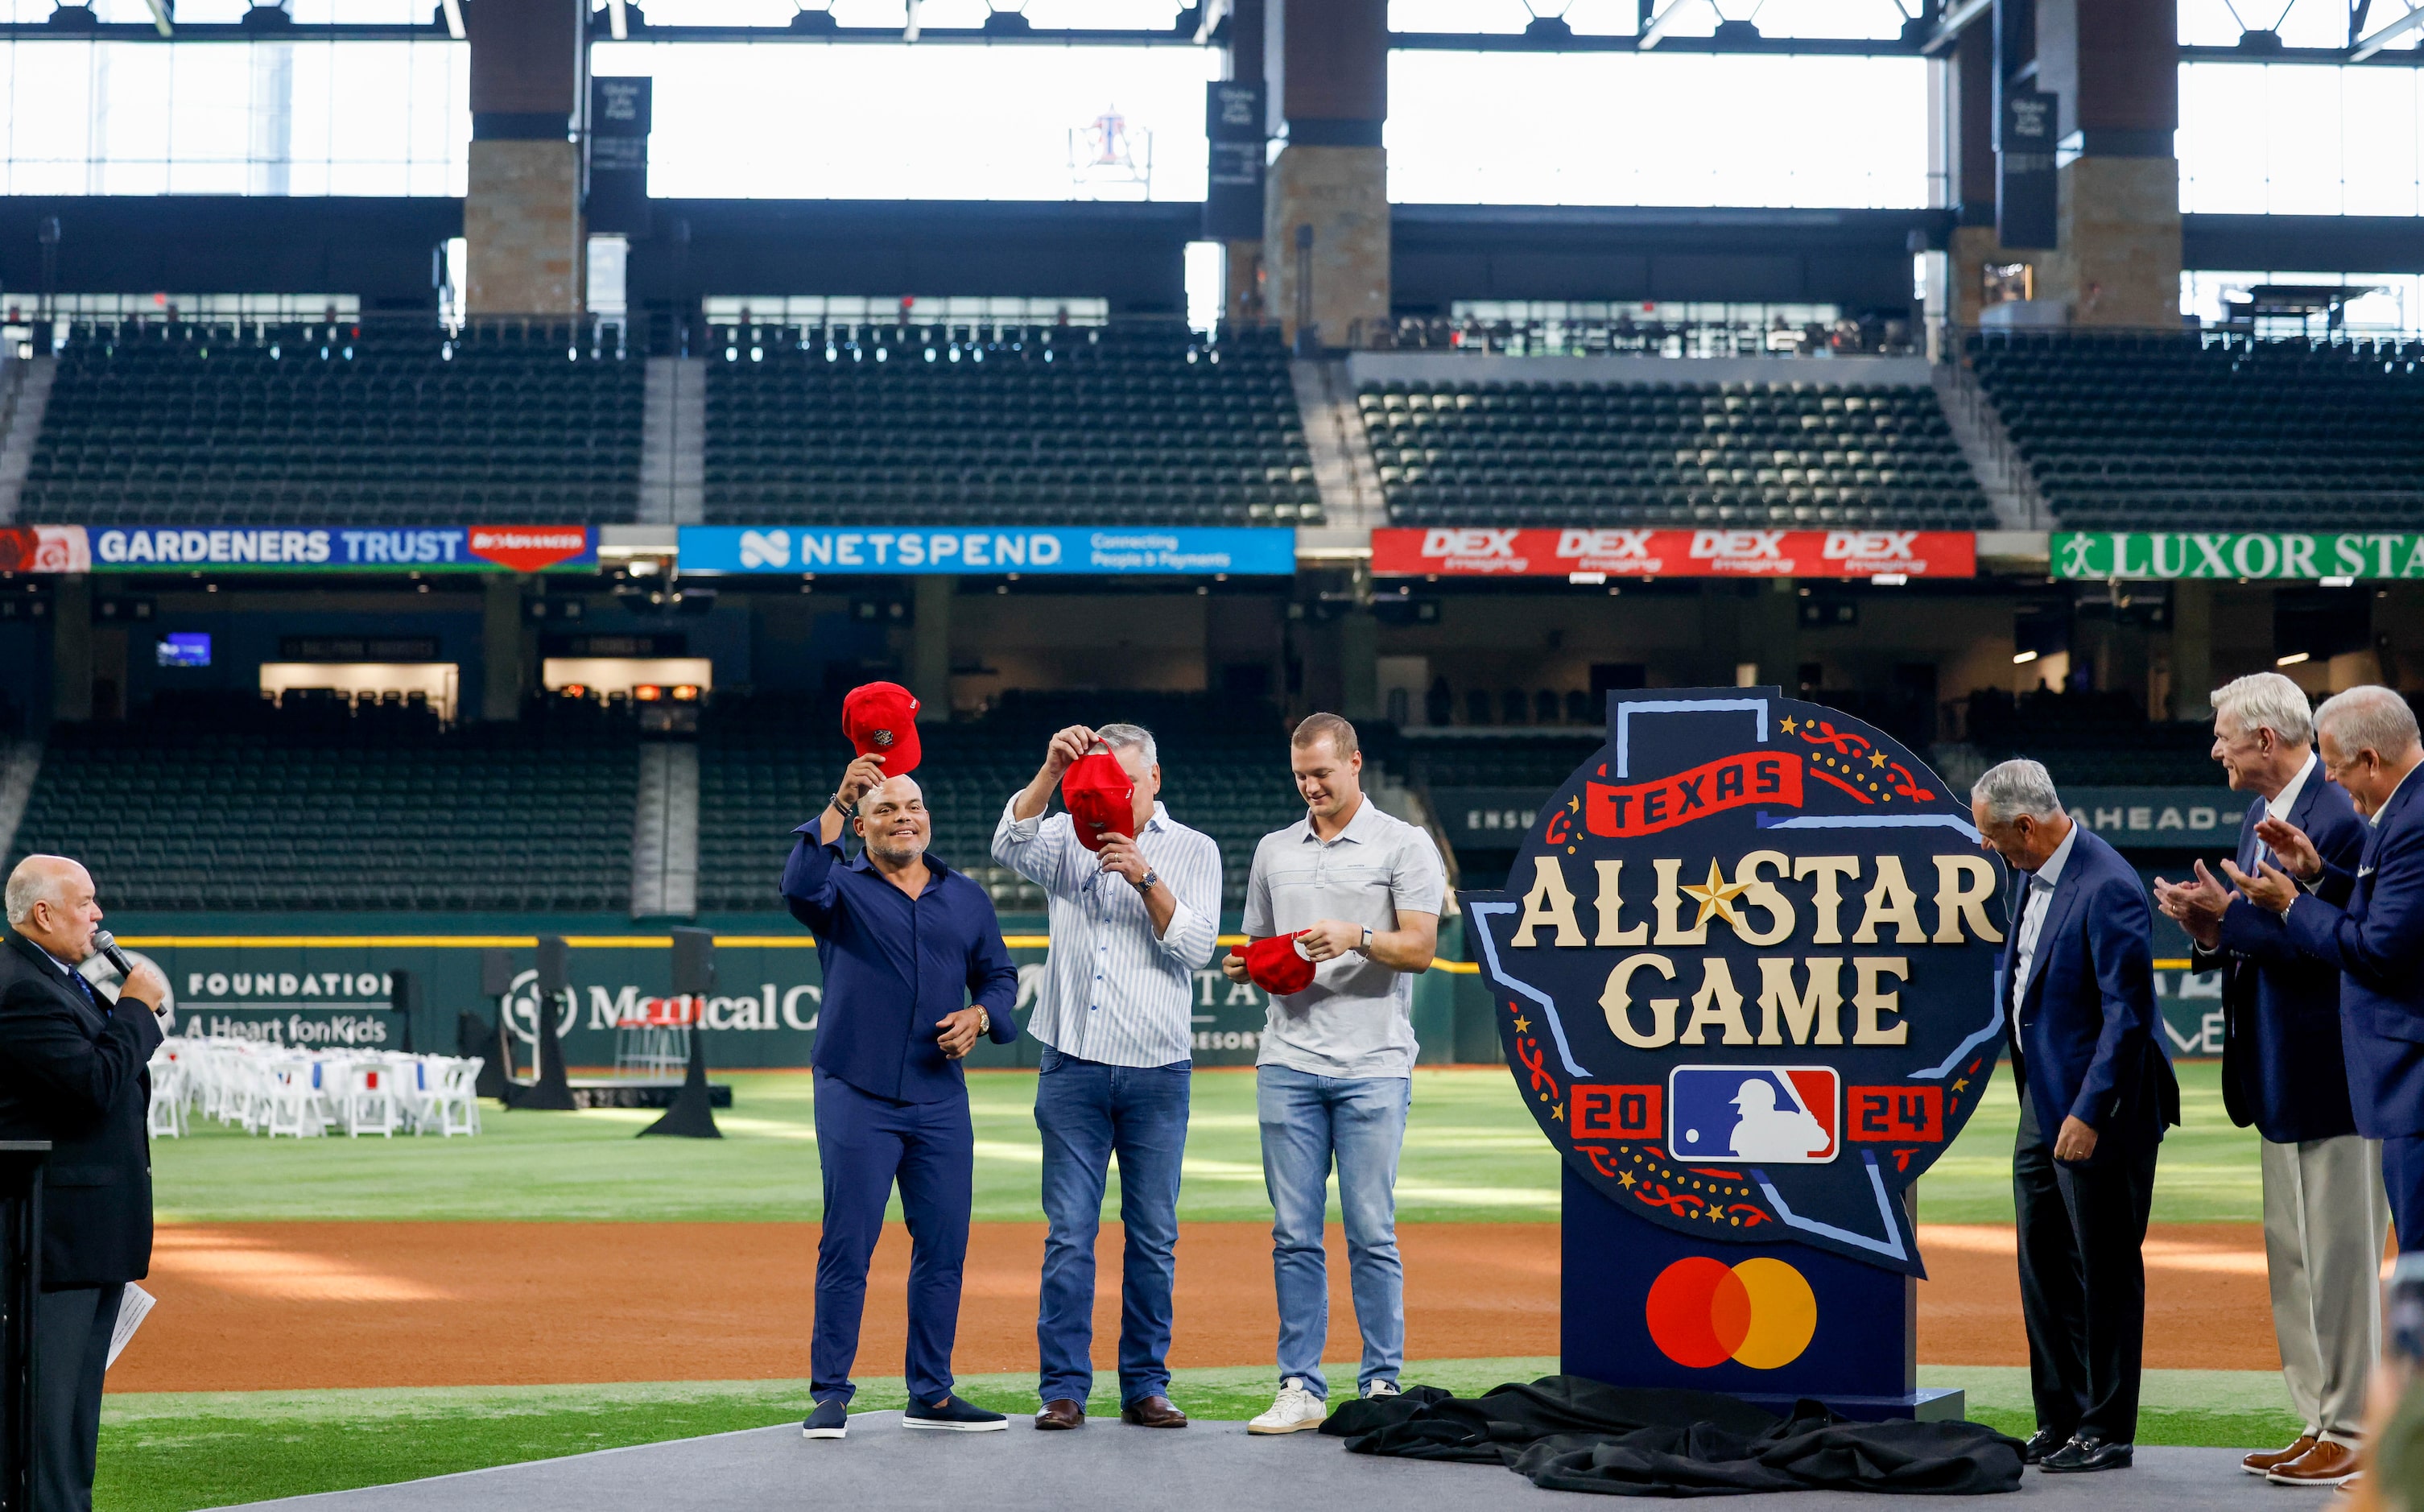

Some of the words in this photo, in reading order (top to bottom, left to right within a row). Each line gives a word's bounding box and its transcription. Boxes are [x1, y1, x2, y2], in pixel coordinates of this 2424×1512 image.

[98, 530, 331, 563] GARDENERS
[341, 531, 463, 562] TRUST
[801, 533, 1061, 566] NETSPEND
[1090, 532, 1179, 552] Connecting
[1421, 528, 1520, 558] DEX
[1555, 528, 1654, 558] DEX
[1689, 529, 1787, 559] DEX
[1822, 530, 1920, 560] DEX
[2109, 533, 2324, 579] LUXOR
[1090, 551, 1142, 570] People
[1144, 551, 1157, 567] &
[1158, 551, 1231, 570] Payments
[1608, 760, 1781, 829] TEXAS
[2069, 806, 2218, 830] AHEAD
[1597, 952, 1910, 1049] GAME
[184, 1014, 204, 1039] A
[210, 1015, 284, 1042] Heart
[331, 1014, 387, 1044] Kids
[1584, 1093, 1648, 1130] 20
[1861, 1093, 1929, 1133] 24
